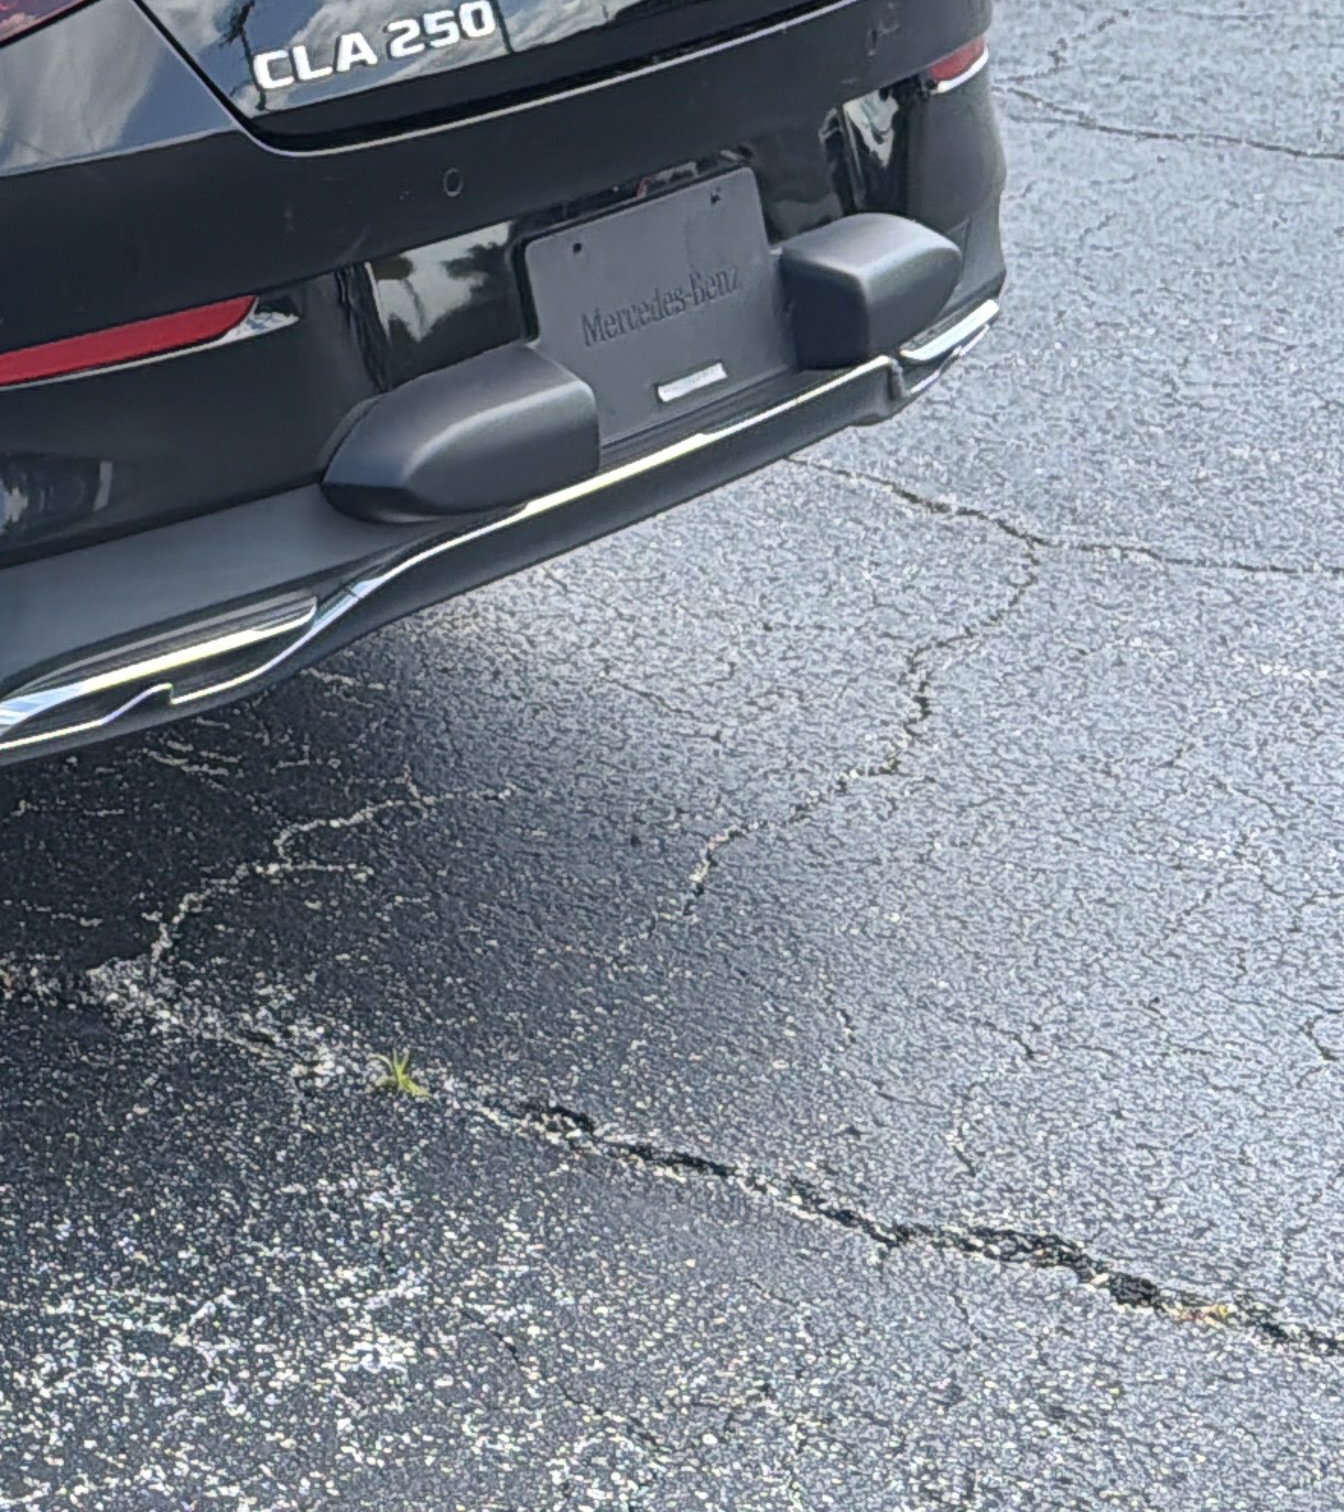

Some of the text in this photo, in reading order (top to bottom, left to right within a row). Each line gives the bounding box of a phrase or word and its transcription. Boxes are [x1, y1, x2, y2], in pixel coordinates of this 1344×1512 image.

[253, 0, 497, 89] CLA 250
[581, 265, 740, 348] Mercedes-Benz
